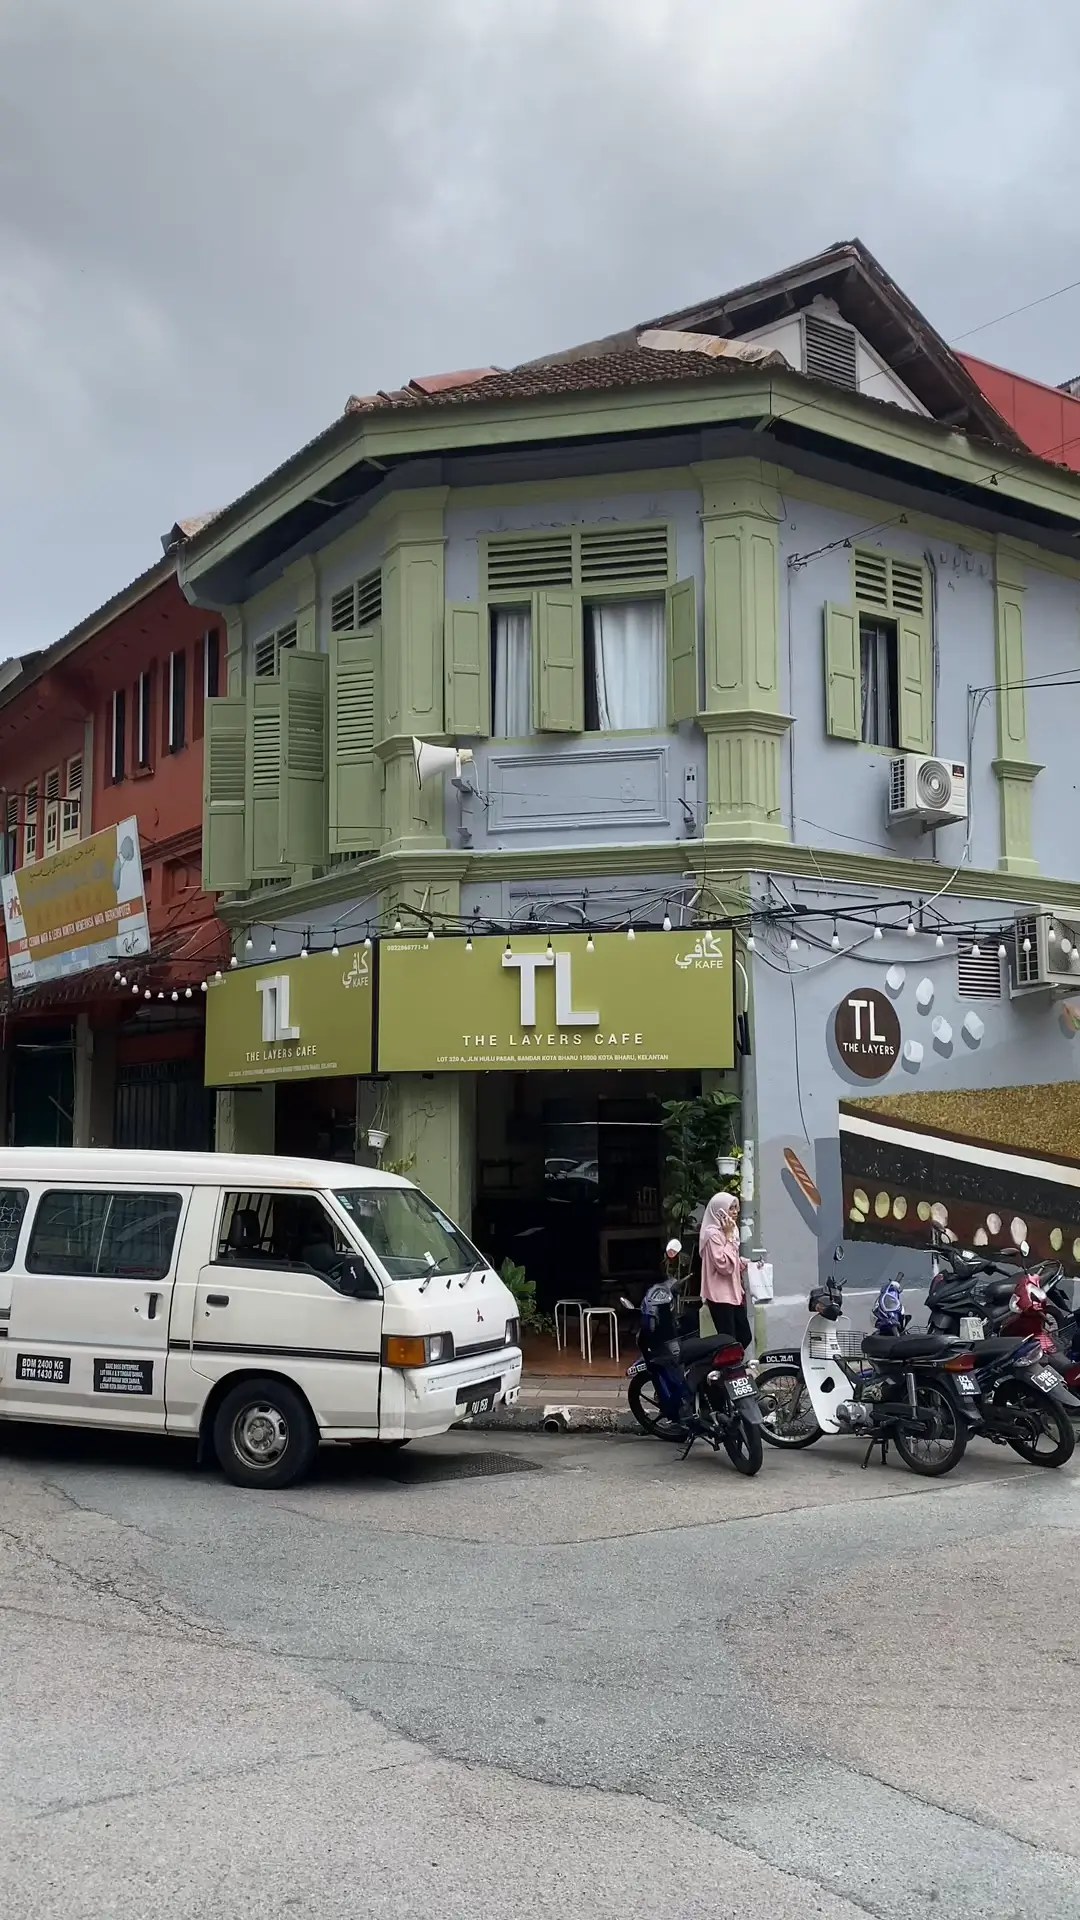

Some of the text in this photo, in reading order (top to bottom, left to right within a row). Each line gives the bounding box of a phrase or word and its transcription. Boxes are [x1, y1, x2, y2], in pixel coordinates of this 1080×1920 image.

[675, 937, 723, 969] كافي
[342, 950, 369, 989] كافي
[695, 960, 723, 969] KAFE
[352, 976, 369, 988] KAFE
[501, 951, 600, 1027] TL
[255, 975, 300, 1042] TL
[848, 998, 886, 1042] TL
[462, 1032, 644, 1046] THE LAYERS CAFE
[246, 1045, 317, 1062] THE LAYERS CAFE
[842, 1042, 895, 1056] THE LAYERS
[496, 1055, 516, 1063] PASAR,
[614, 1054, 637, 1062] BHARU,
[22, 1358, 64, 1370] BDM 2400 KG
[766, 1355, 780, 1363] DCL
[21, 1368, 63, 1380] BTM 1430 KG
[958, 1375, 972, 1383] DCL
[732, 1378, 748, 1388] DED
[734, 1384, 753, 1396] 1665
